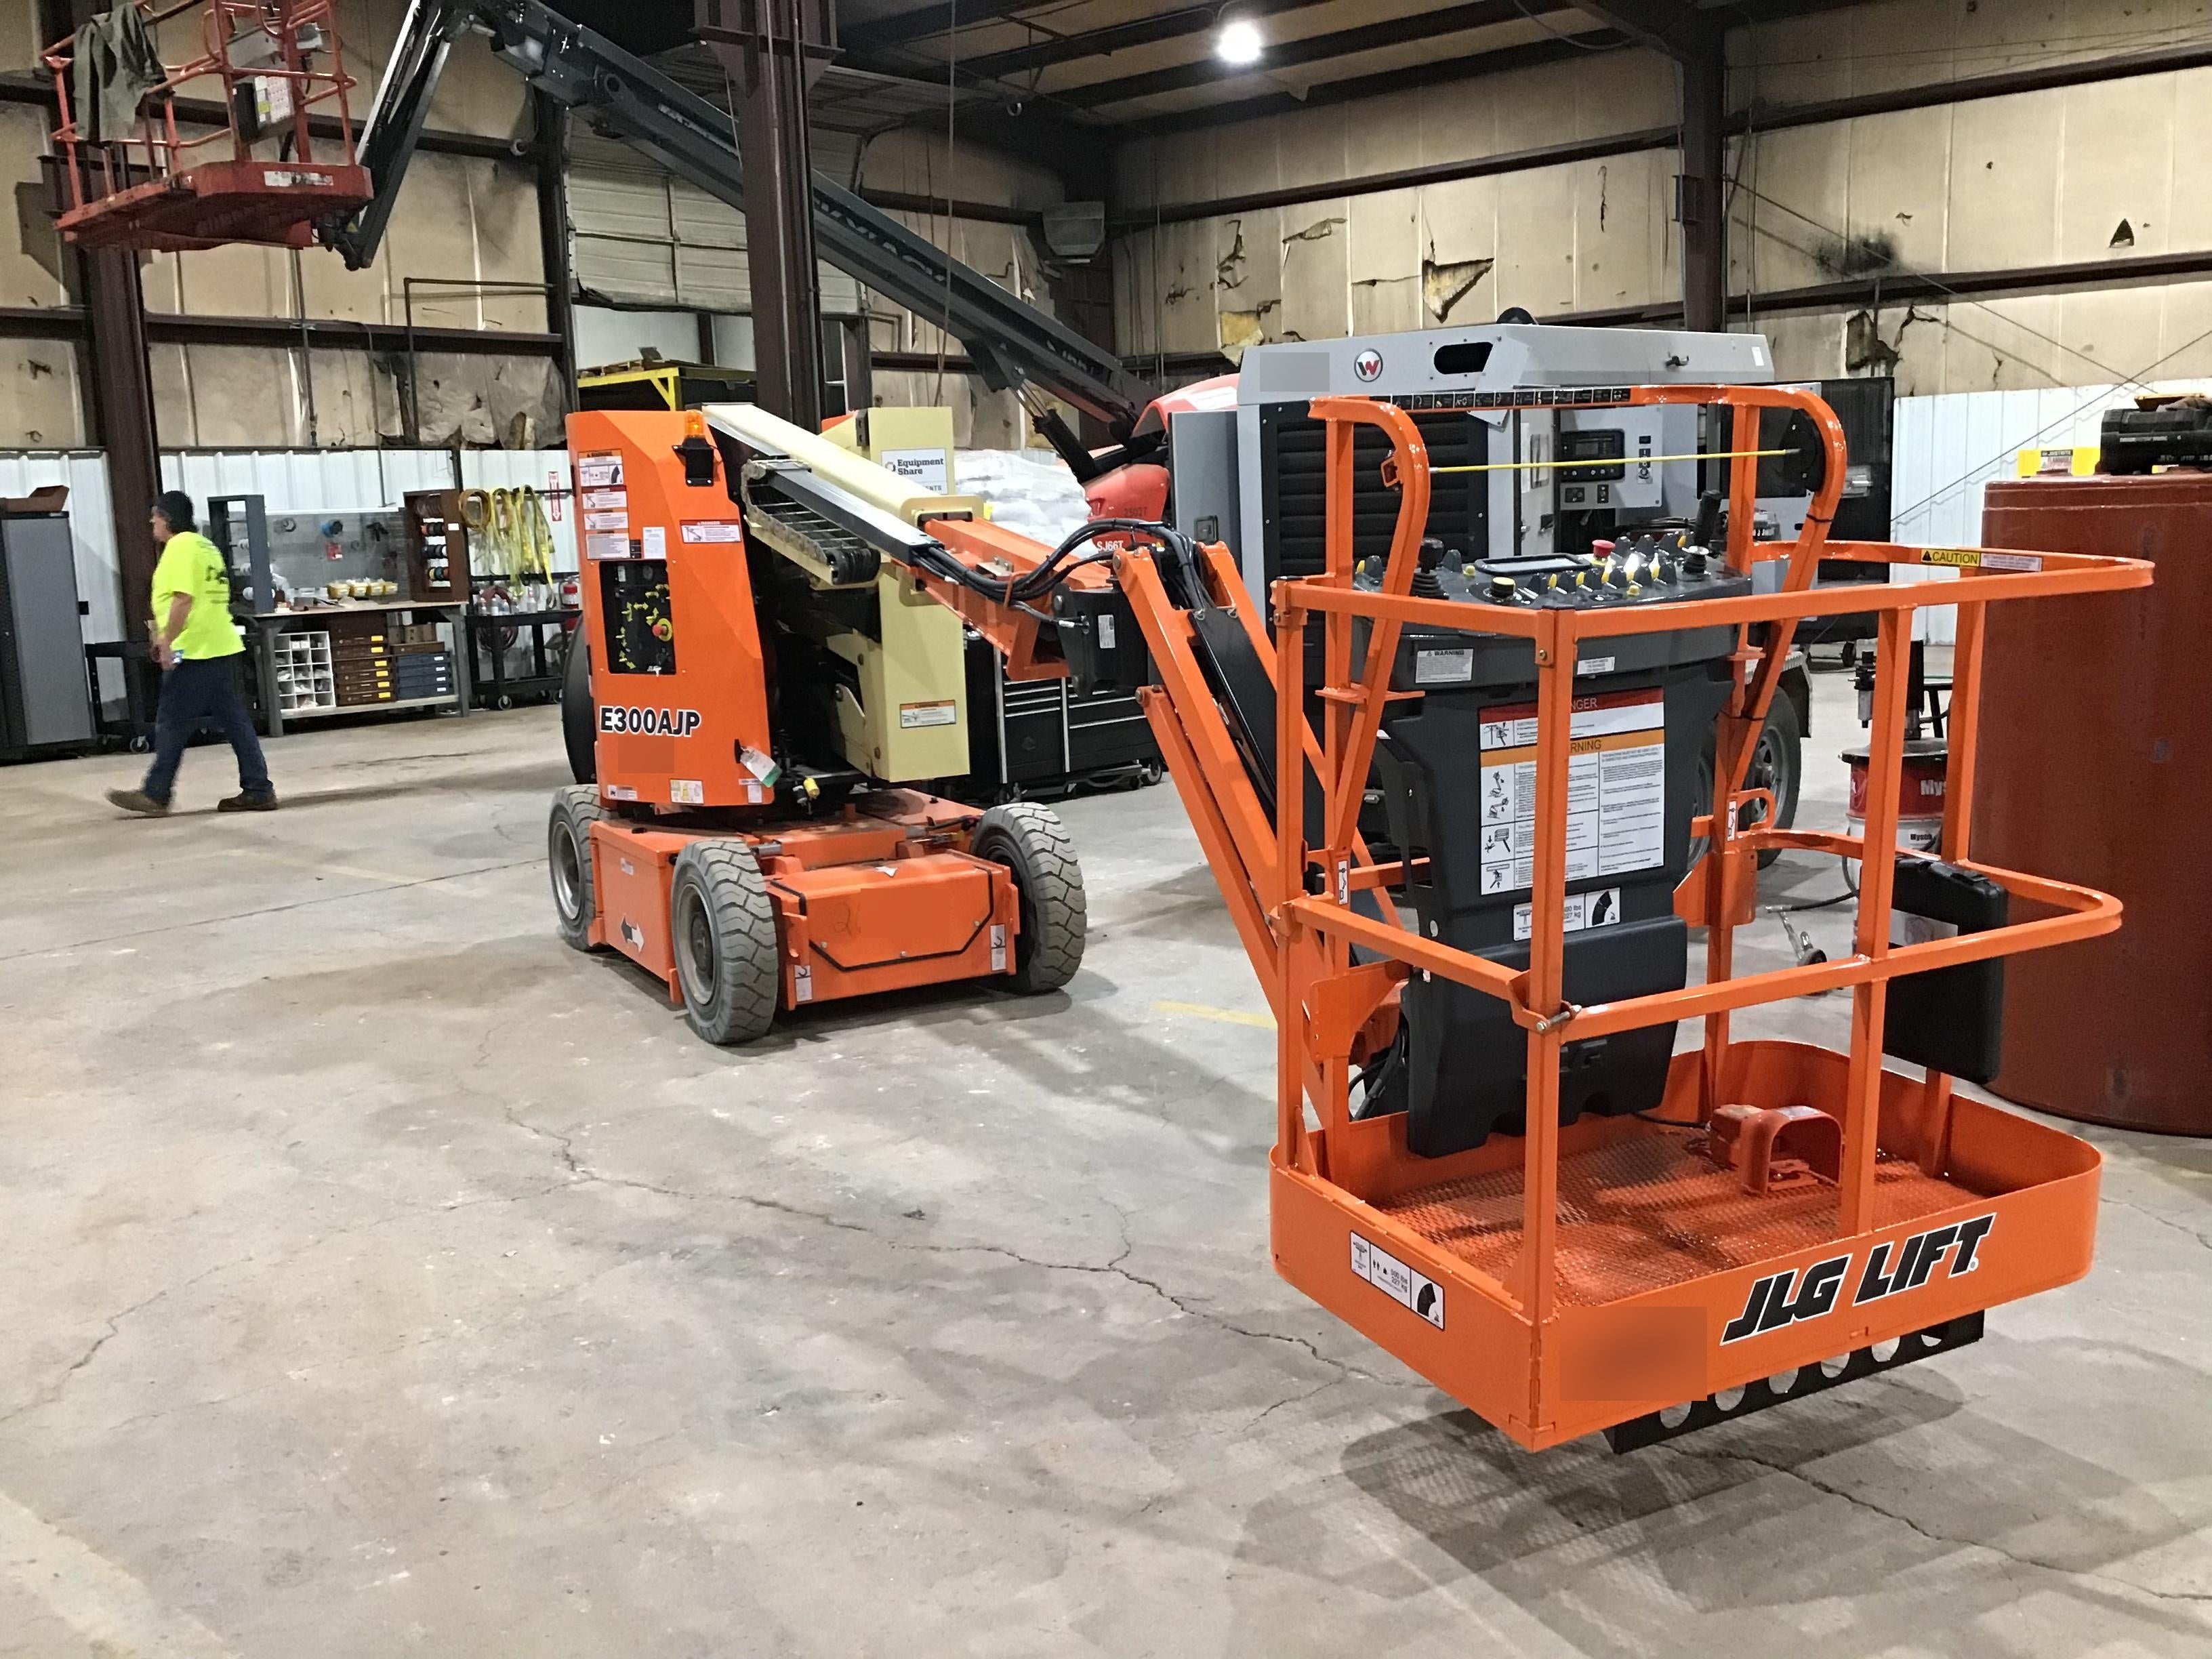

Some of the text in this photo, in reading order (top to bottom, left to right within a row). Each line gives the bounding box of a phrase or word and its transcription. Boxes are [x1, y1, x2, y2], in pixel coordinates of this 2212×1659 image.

[897, 458, 944, 468] Equipment
[897, 468, 923, 476] Share
[1097, 539, 1124, 552] SJ66T
[1932, 551, 1978, 565] CAUTION
[600, 705, 701, 737] E300AJP
[1570, 739, 1602, 754] RNING
[1719, 1212, 1998, 1347] JLG LIFT
